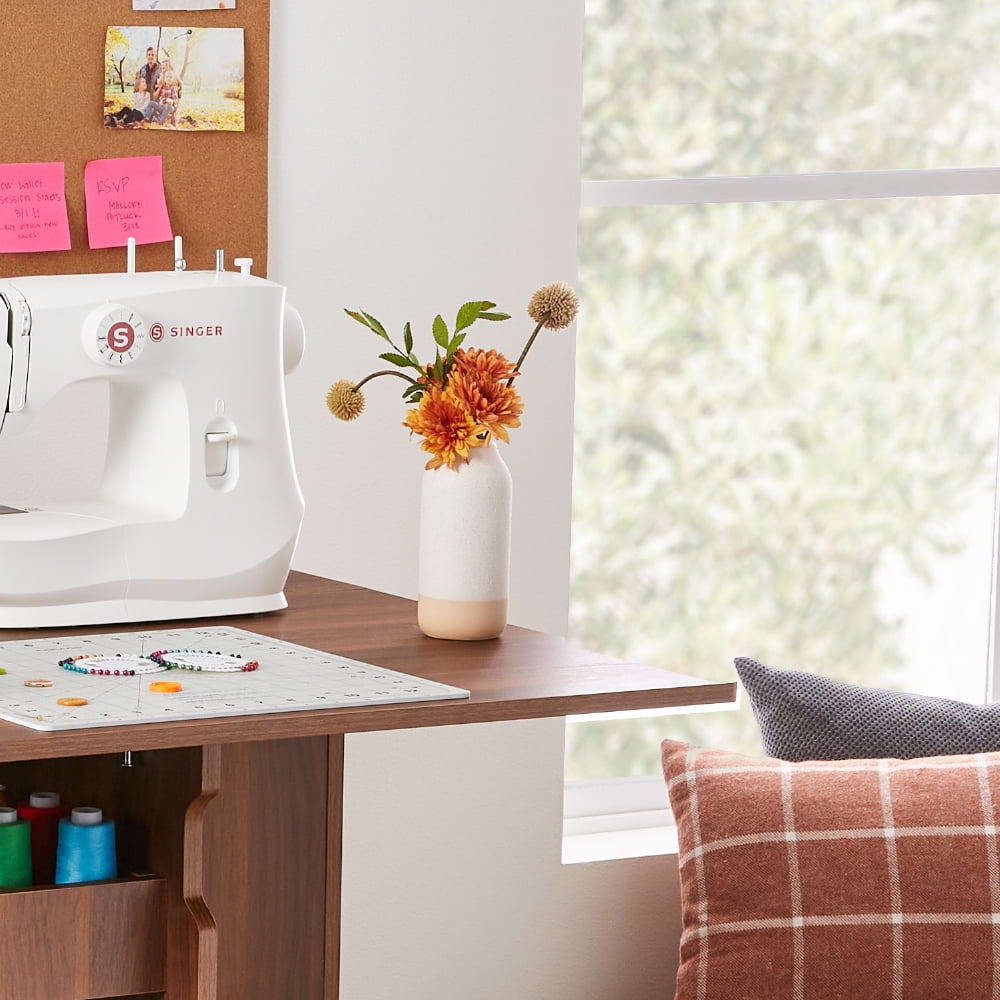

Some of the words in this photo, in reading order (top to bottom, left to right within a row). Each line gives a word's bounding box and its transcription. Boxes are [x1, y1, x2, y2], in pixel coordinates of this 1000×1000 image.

[96, 176, 130, 195] RSVP
[113, 327, 129, 348] S
[170, 325, 223, 337] SINGER
